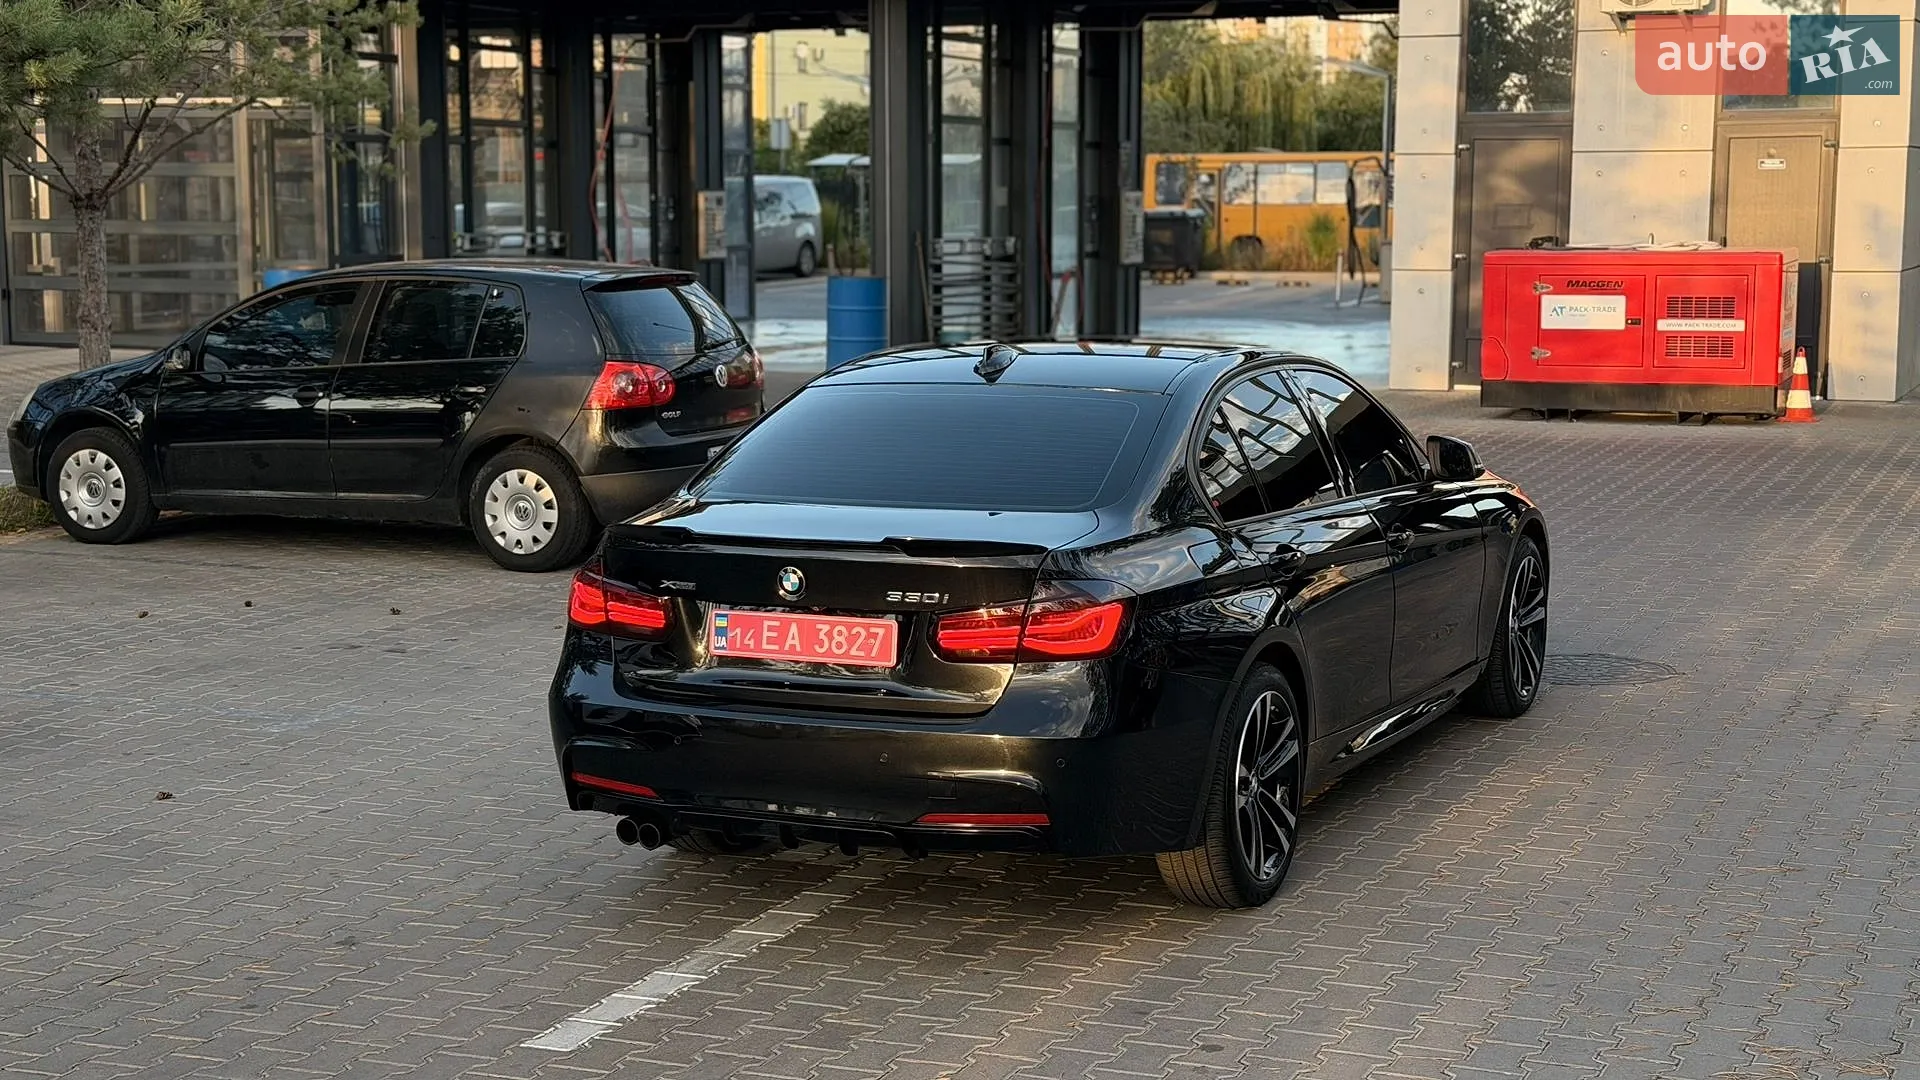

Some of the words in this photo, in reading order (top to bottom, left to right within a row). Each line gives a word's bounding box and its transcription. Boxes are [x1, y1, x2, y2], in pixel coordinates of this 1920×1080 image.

[886, 591, 949, 604] 330i
[714, 635, 727, 648] UA
[762, 620, 801, 652] EA
[814, 623, 886, 658] 3827
